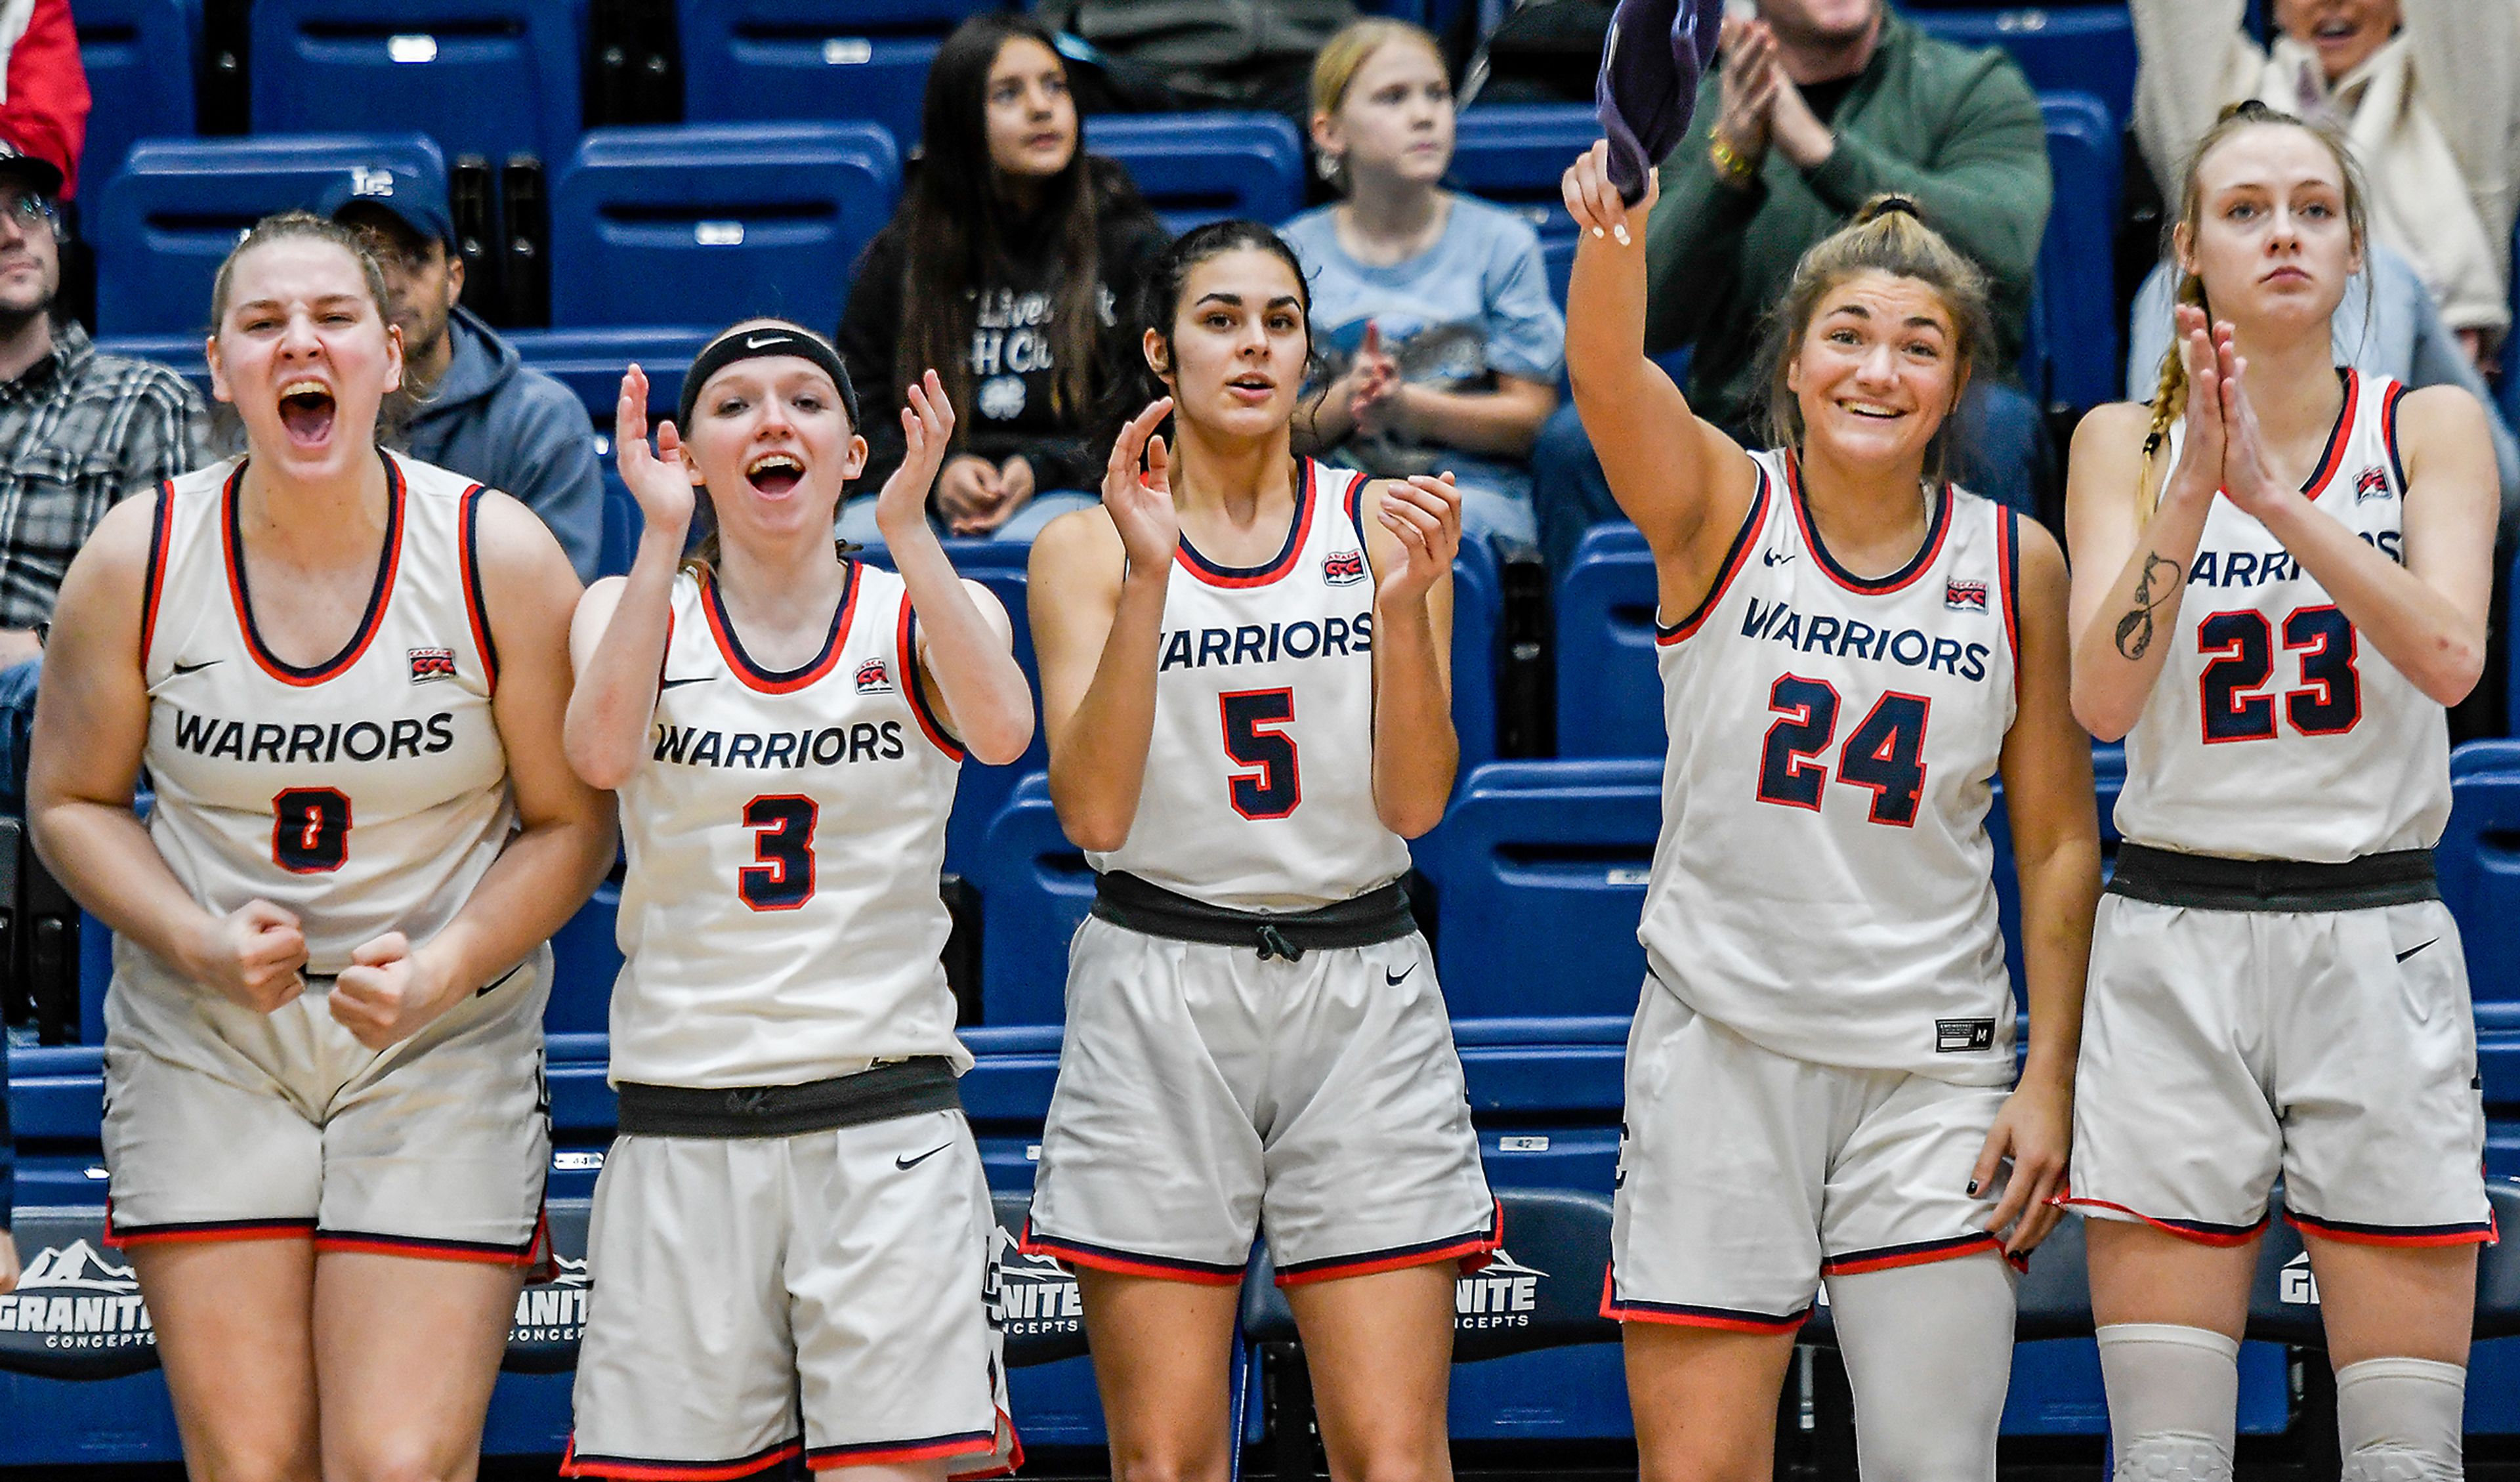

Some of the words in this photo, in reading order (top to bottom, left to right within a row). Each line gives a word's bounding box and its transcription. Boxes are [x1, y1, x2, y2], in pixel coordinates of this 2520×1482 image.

[2187, 531, 2403, 588] ARRIS
[1160, 612, 1372, 671] ARRIORS
[1740, 597, 1991, 683] WARRIORS
[2197, 604, 2362, 745] 23
[173, 711, 454, 763] WARRIORS
[653, 721, 904, 769] WARRIORS
[1219, 687, 1302, 821] 5
[1755, 671, 1931, 828] 24
[272, 787, 352, 874] 0
[738, 794, 819, 912] 3
[1976, 1028, 1988, 1042] M
[514, 1290, 587, 1326] ANIT
[1003, 1282, 1083, 1319] NITE
[1456, 1277, 1537, 1313] NITE
[45, 1332, 158, 1349] CONCEPTS
[1003, 1320, 1078, 1334] NCEPTS
[1454, 1315, 1529, 1328] CEPTS
